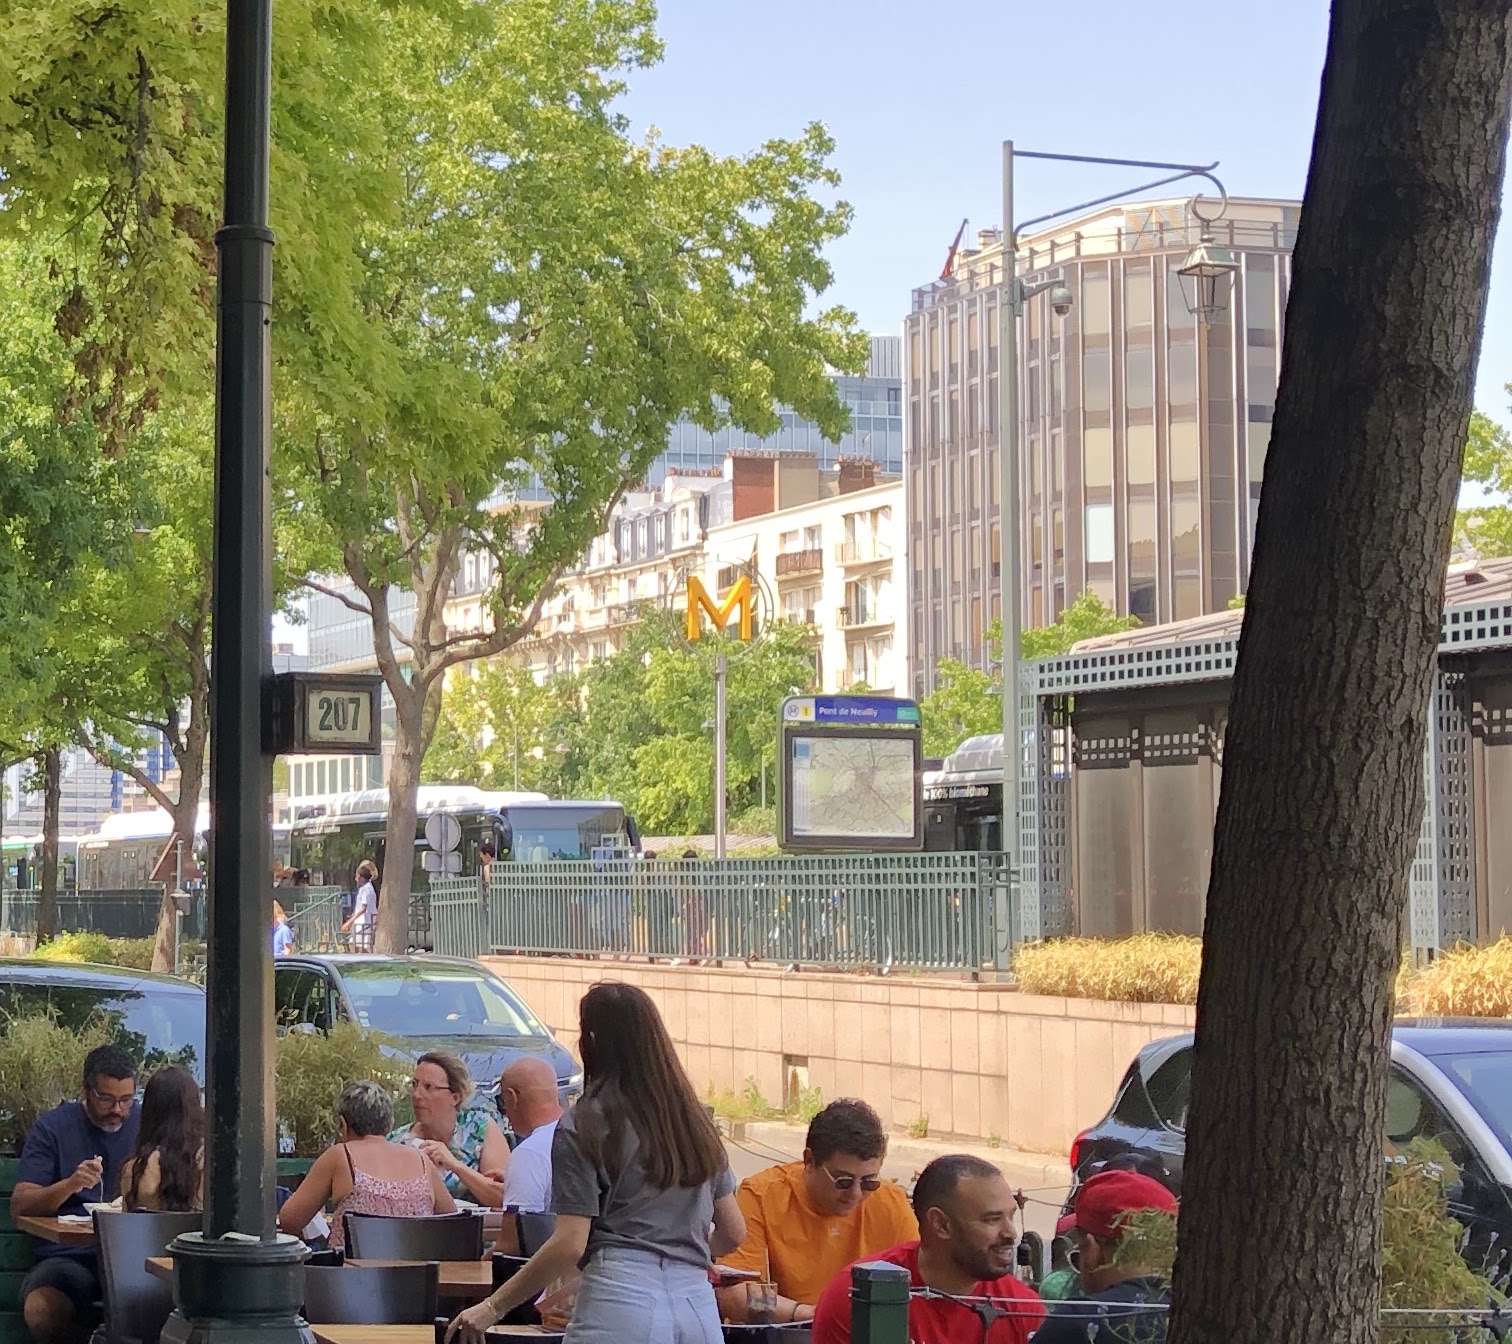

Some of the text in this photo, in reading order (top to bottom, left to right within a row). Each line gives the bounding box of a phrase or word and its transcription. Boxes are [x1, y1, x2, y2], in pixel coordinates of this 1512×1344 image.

[687, 575, 751, 641] M
[318, 696, 361, 731] 207
[819, 706, 837, 716] Pont
[839, 707, 849, 716] de
[851, 707, 878, 718] Neuilly
